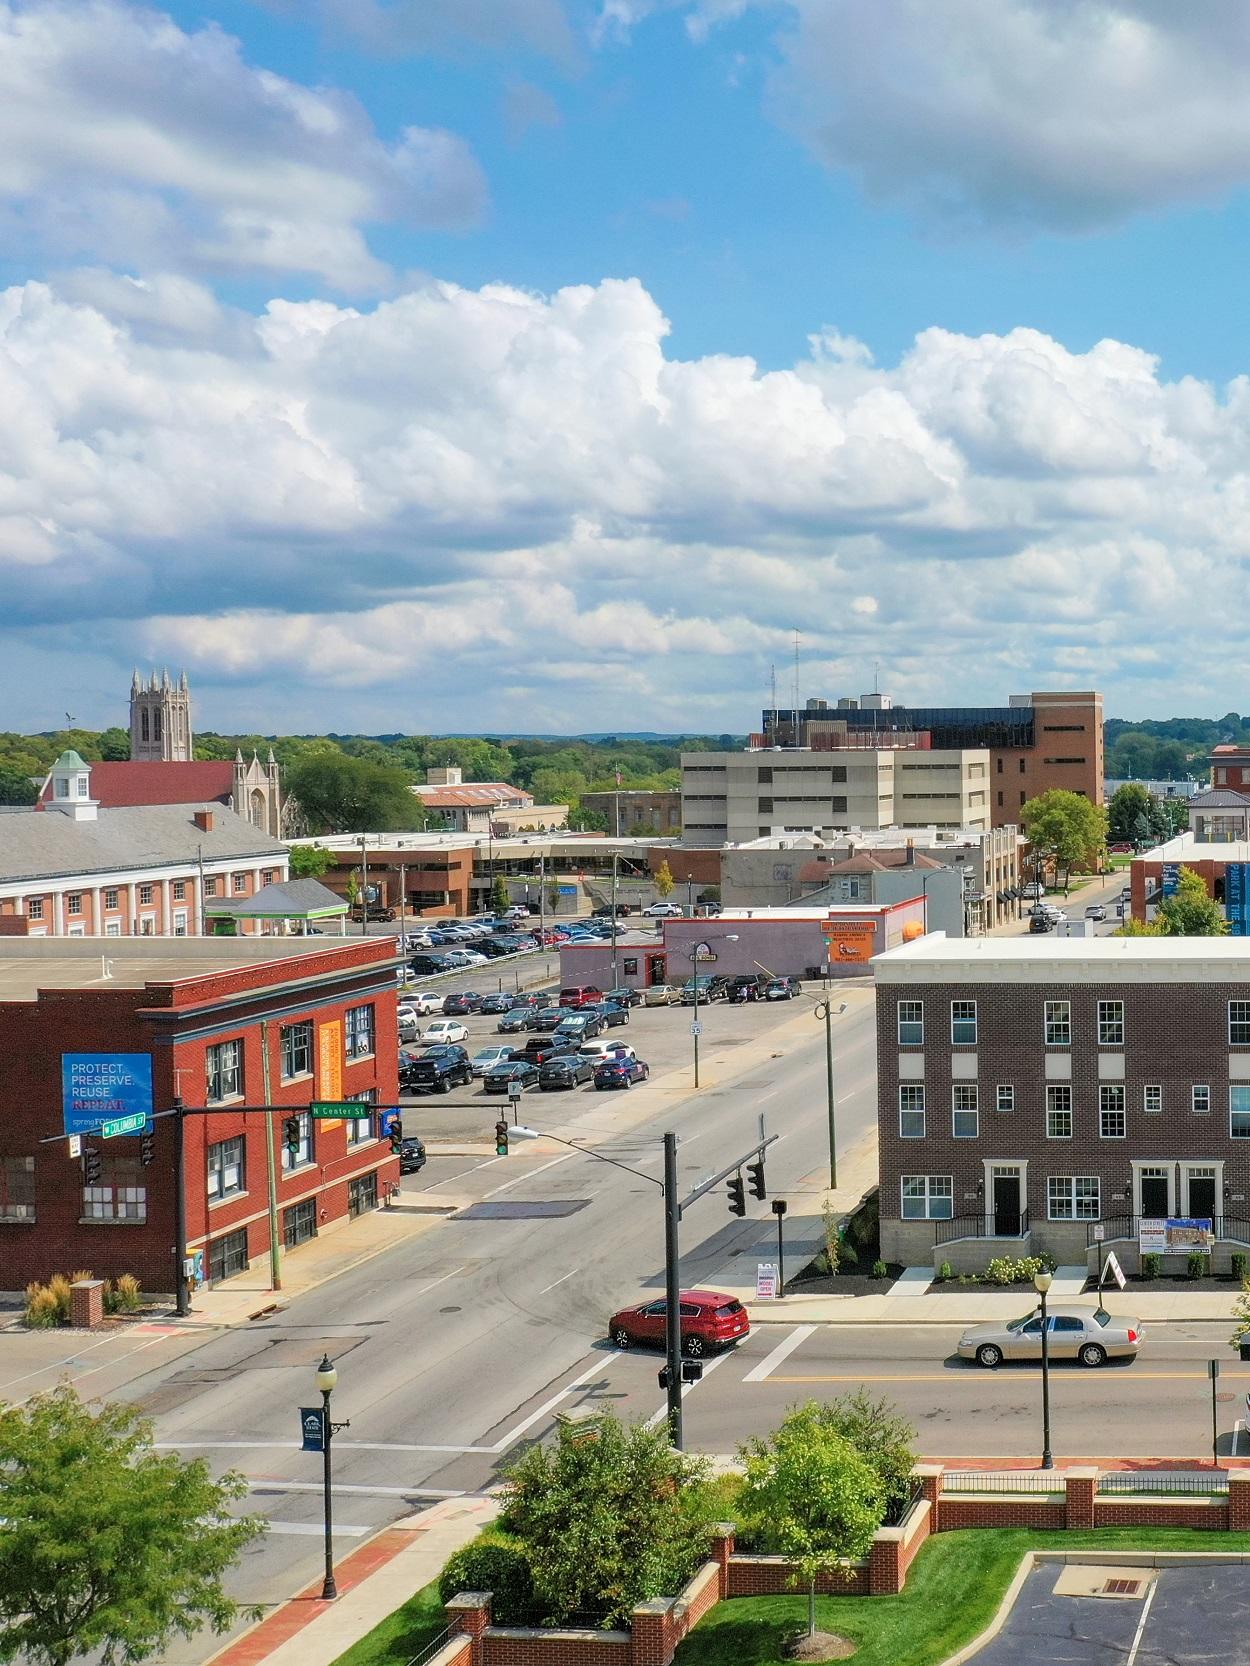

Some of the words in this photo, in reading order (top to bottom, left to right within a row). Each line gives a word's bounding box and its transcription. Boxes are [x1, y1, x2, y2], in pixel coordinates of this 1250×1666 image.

[1231, 864, 1240, 889] PARK
[1231, 889, 1240, 900] AT
[1231, 904, 1240, 921] THE
[71, 1063, 124, 1074] PROTECT.
[71, 1075, 135, 1086] PRESERVE.
[71, 1087, 113, 1097] REUSE.
[72, 1099, 127, 1111] REPEAT.
[111, 1117, 137, 1135] COLUMBIA
[137, 1116, 144, 1125] ST
